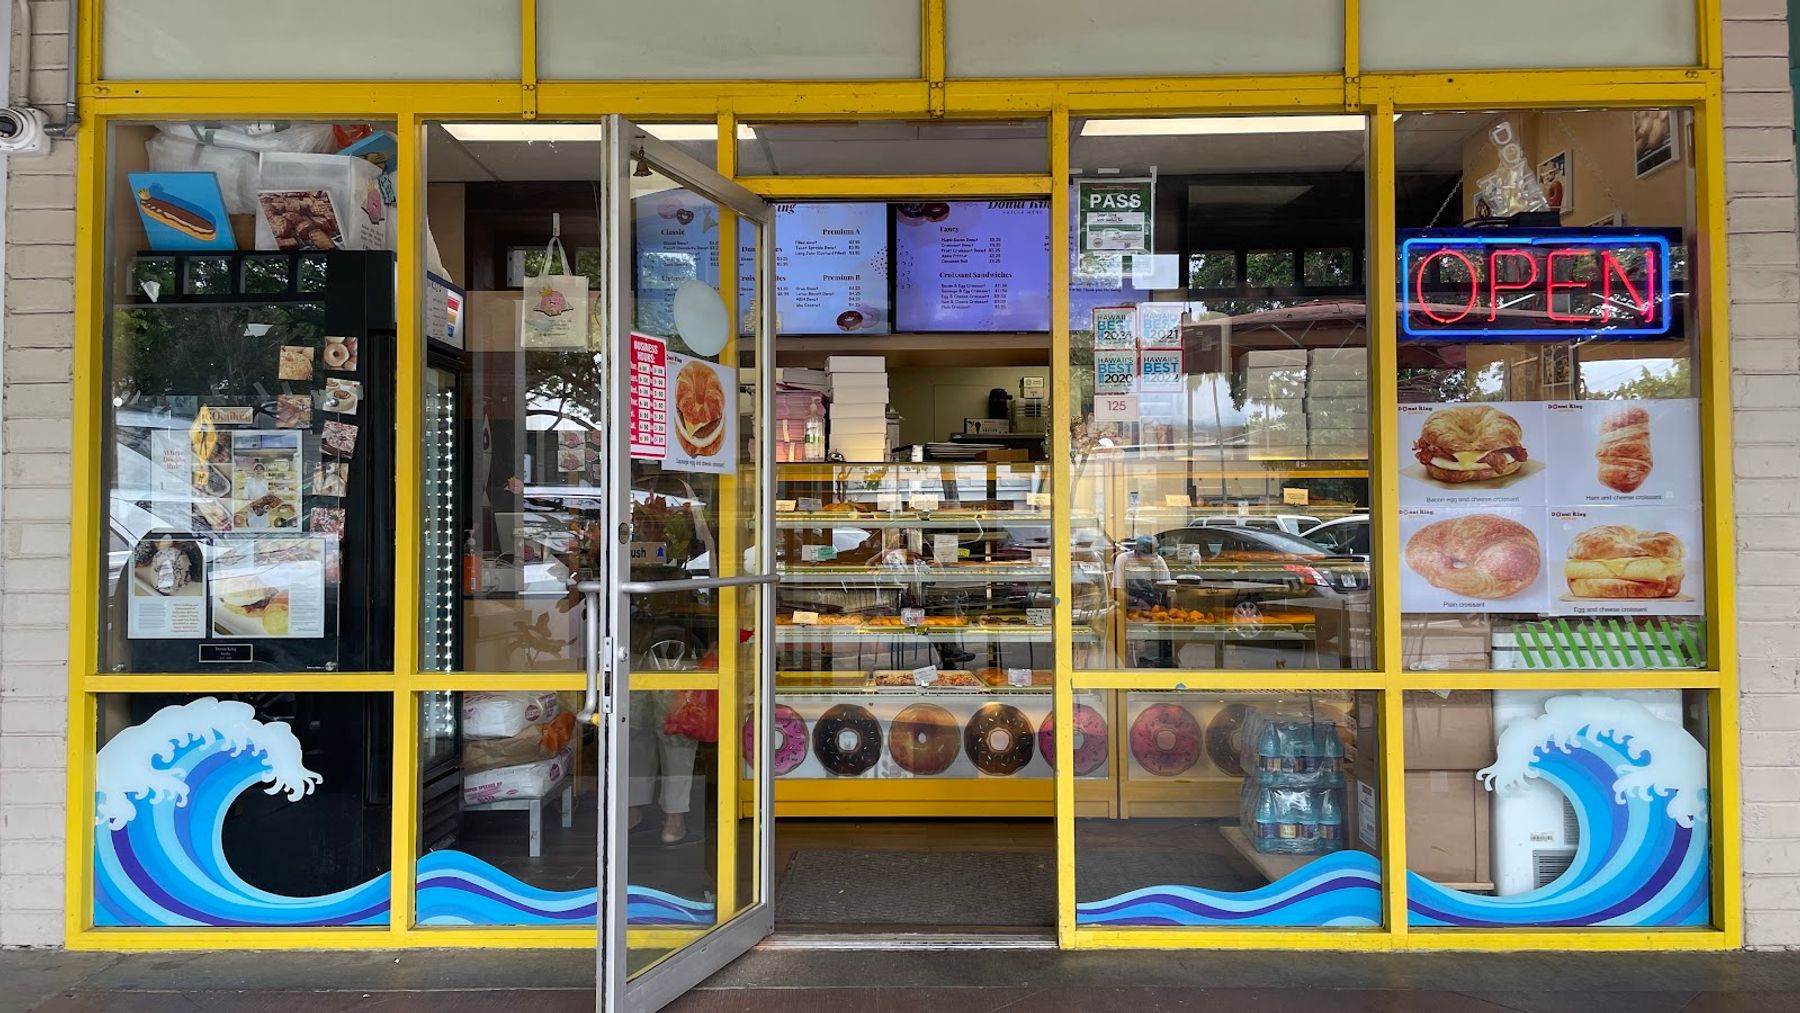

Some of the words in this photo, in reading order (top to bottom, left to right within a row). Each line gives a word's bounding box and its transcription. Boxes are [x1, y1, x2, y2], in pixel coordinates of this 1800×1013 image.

[1029, 201, 1050, 210] Kin
[1090, 193, 1142, 209] PASS
[777, 203, 796, 214] ing
[1416, 248, 1655, 324] OPEN
[1097, 320, 1132, 331] BEST
[1144, 319, 1177, 329] BEST
[1150, 330, 1179, 340] 2021
[1098, 363, 1133, 374] BEST
[1144, 363, 1179, 373] BEST
[1104, 374, 1133, 384] 2020
[1107, 401, 1127, 411] 125
[631, 547, 647, 558] ush
